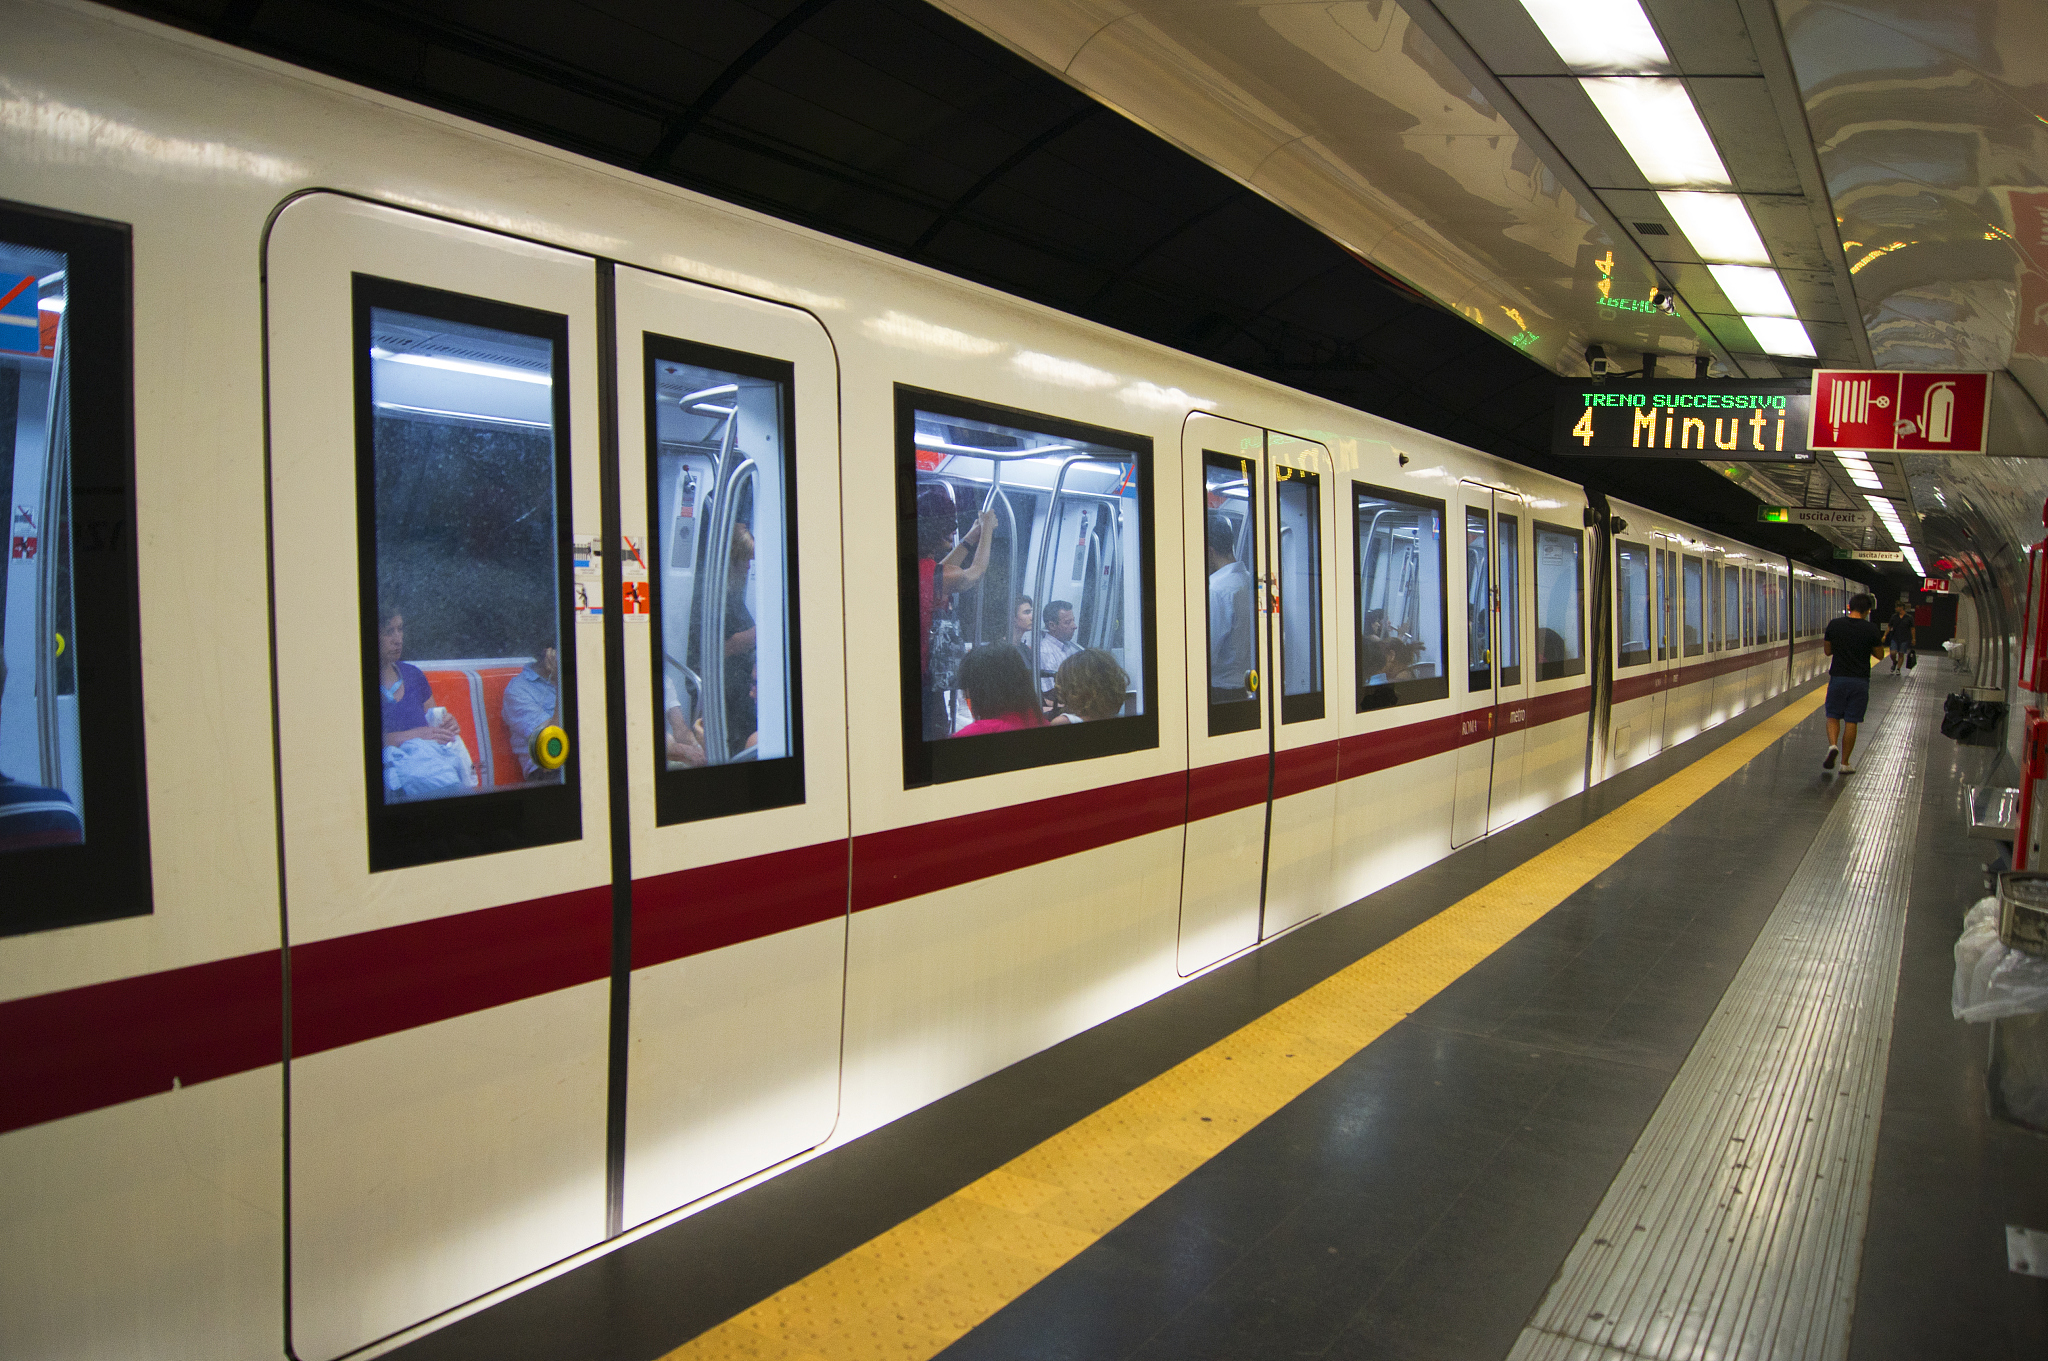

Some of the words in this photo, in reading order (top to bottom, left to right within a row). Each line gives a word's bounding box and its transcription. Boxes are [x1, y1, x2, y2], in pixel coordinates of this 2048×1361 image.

[1582, 393, 1646, 407] TRENO
[1652, 394, 1786, 409] SUCCESSIVO
[1572, 406, 1594, 446] 4
[1632, 406, 1786, 451] Minuti
[1799, 511, 1855, 522] uscita/exit
[1858, 552, 1893, 560] uscita/exit
